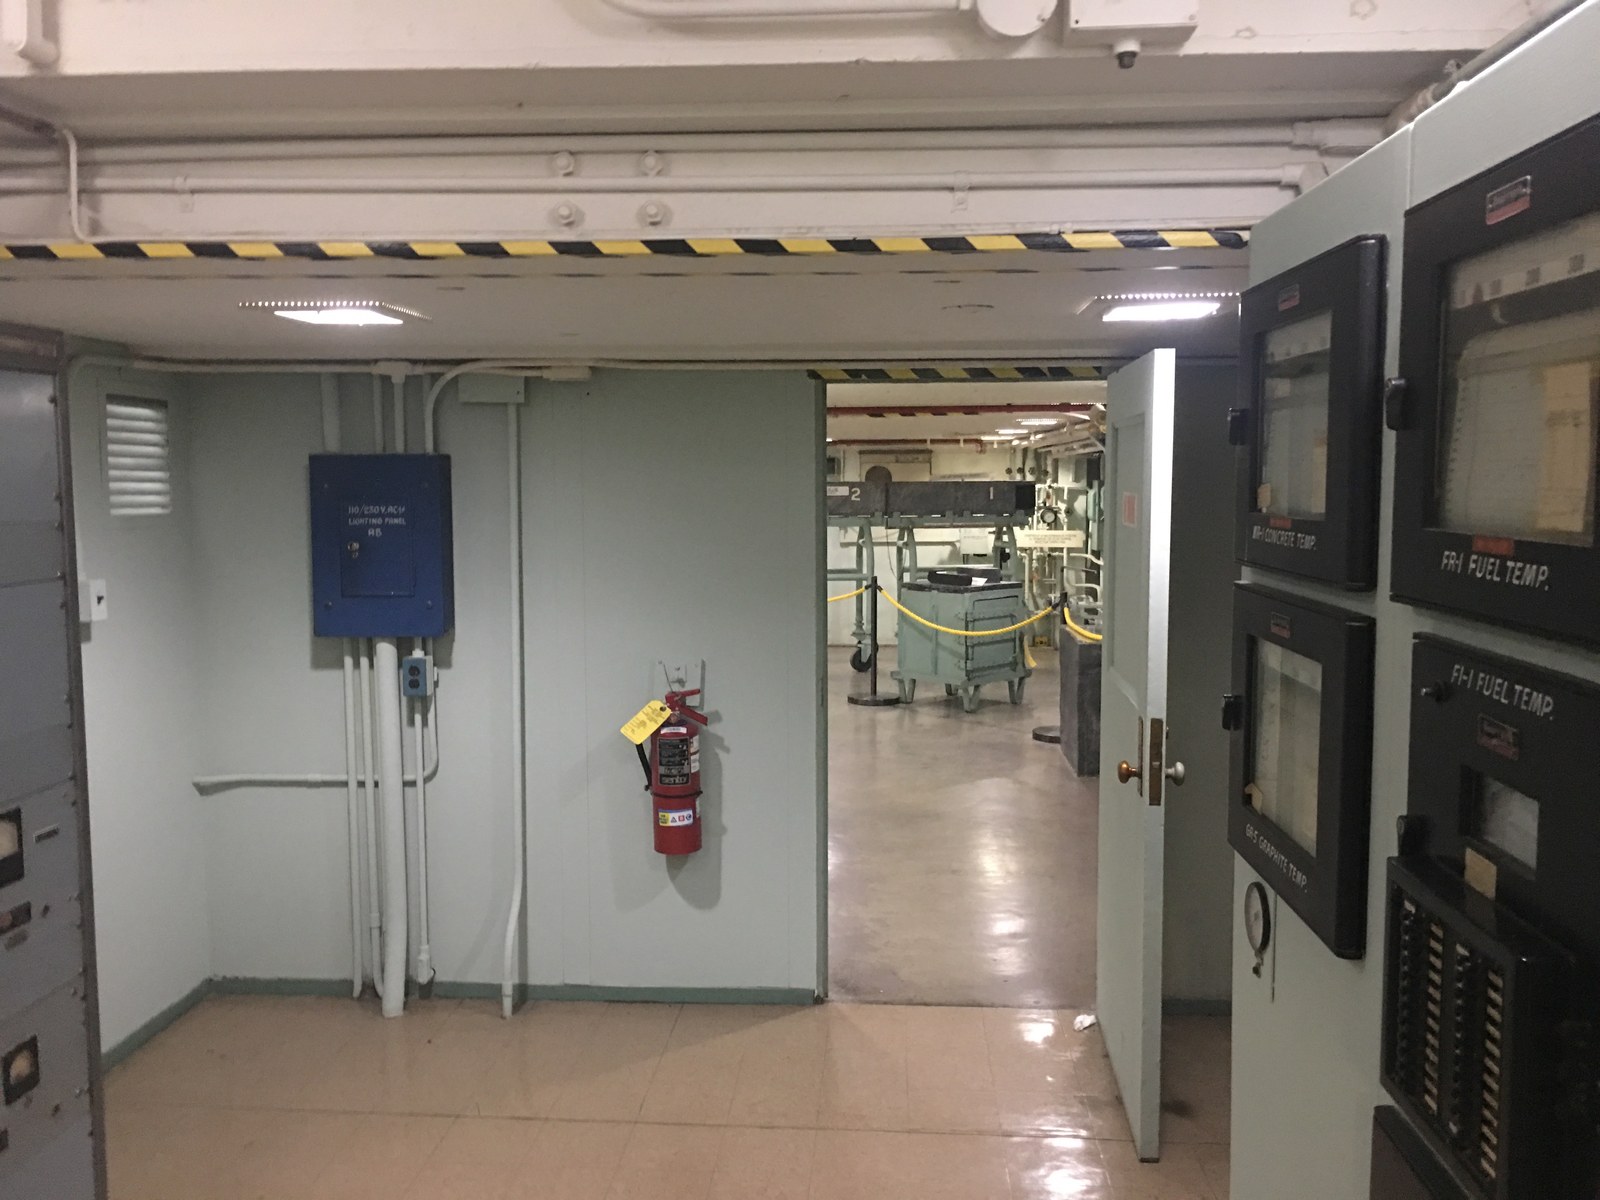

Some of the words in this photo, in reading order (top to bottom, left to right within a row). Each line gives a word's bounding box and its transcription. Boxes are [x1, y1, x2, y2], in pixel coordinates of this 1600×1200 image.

[851, 487, 861, 501] 2
[348, 517, 383, 526] LIGHTING
[384, 517, 407, 526] PANEL
[1265, 527, 1296, 547] CONCRETE
[1441, 550, 1464, 574] FR-1
[1467, 554, 1501, 582] FUEL
[1505, 560, 1550, 592] TEMP.
[1476, 672, 1509, 705] FUEL
[1513, 684, 1554, 721] TEMP.
[1259, 836, 1288, 874] GRAPHITE
[1288, 862, 1308, 894] TEMP.
